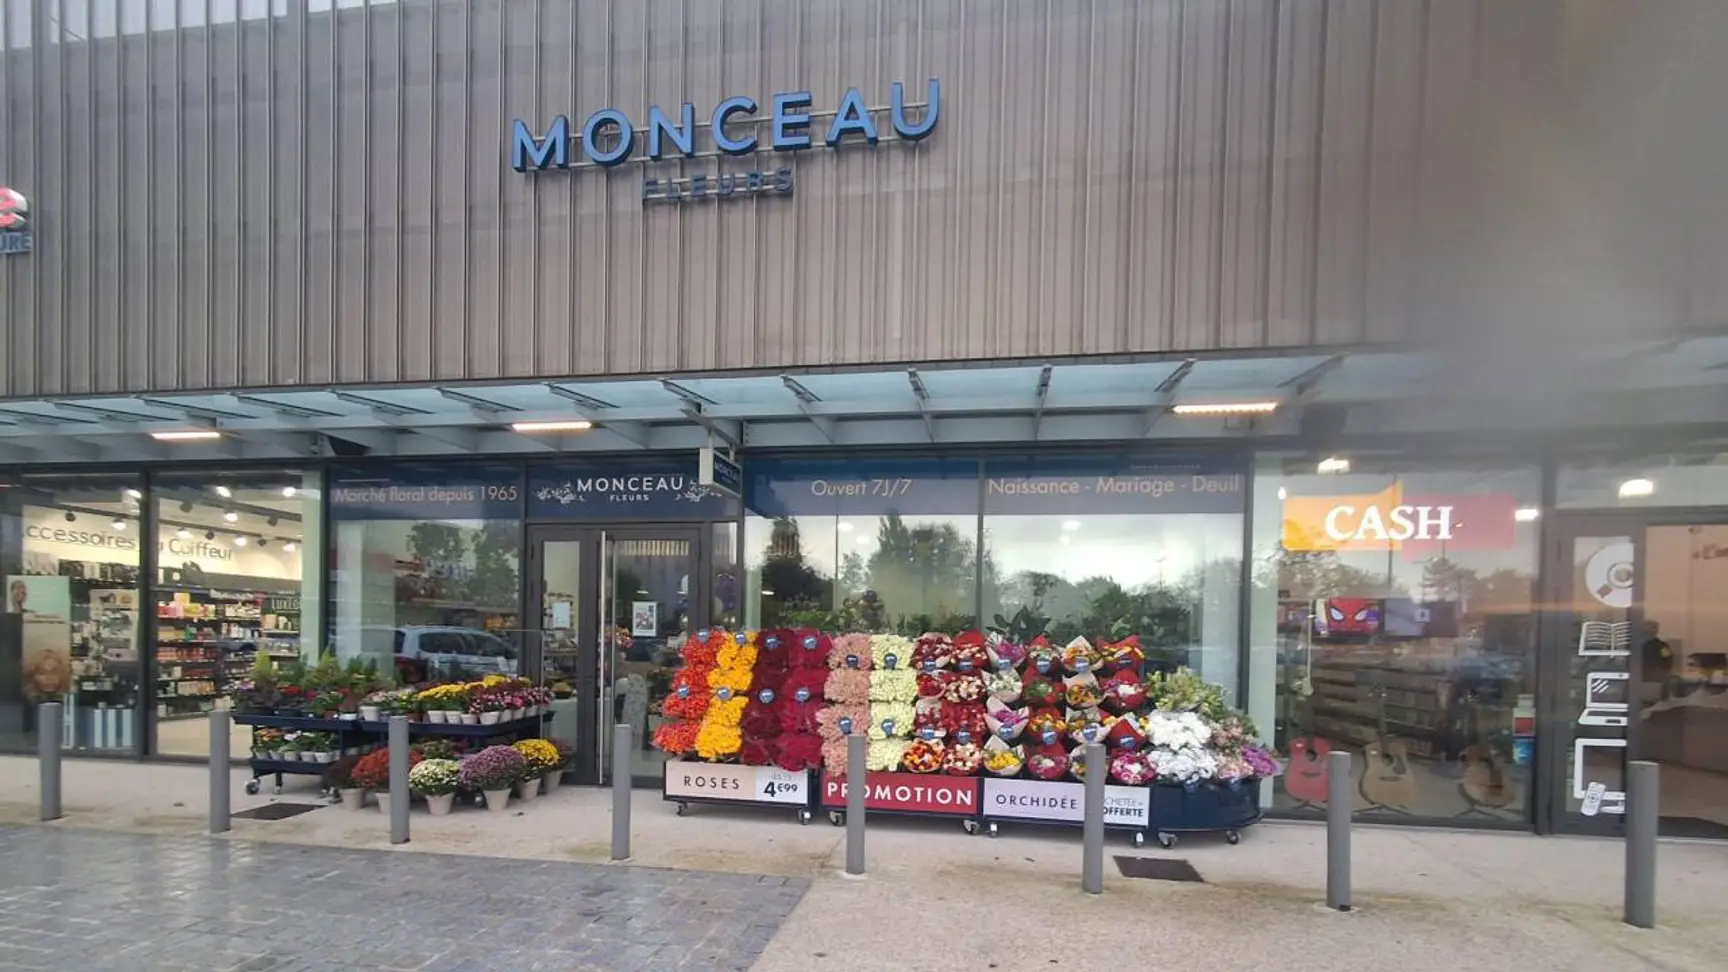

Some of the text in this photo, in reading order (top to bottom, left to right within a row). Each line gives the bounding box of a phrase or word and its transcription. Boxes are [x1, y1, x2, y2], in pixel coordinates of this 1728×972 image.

[512, 78, 940, 172] MONCEAU
[643, 167, 794, 200] FLEURS
[577, 477, 684, 492] MONCEAU
[811, 479, 866, 496] Ouvert
[988, 479, 1080, 496] Naissance
[1096, 476, 1175, 497] Mariage
[1192, 475, 1240, 493] Deuil
[389, 486, 424, 501] floral
[428, 486, 475, 505] depuis
[481, 486, 517, 501] 1965
[1325, 505, 1453, 541] CASH
[26, 525, 136, 550] ccessoires
[683, 775, 740, 790] ROSES
[996, 794, 1077, 810] ORCHIDÉE
